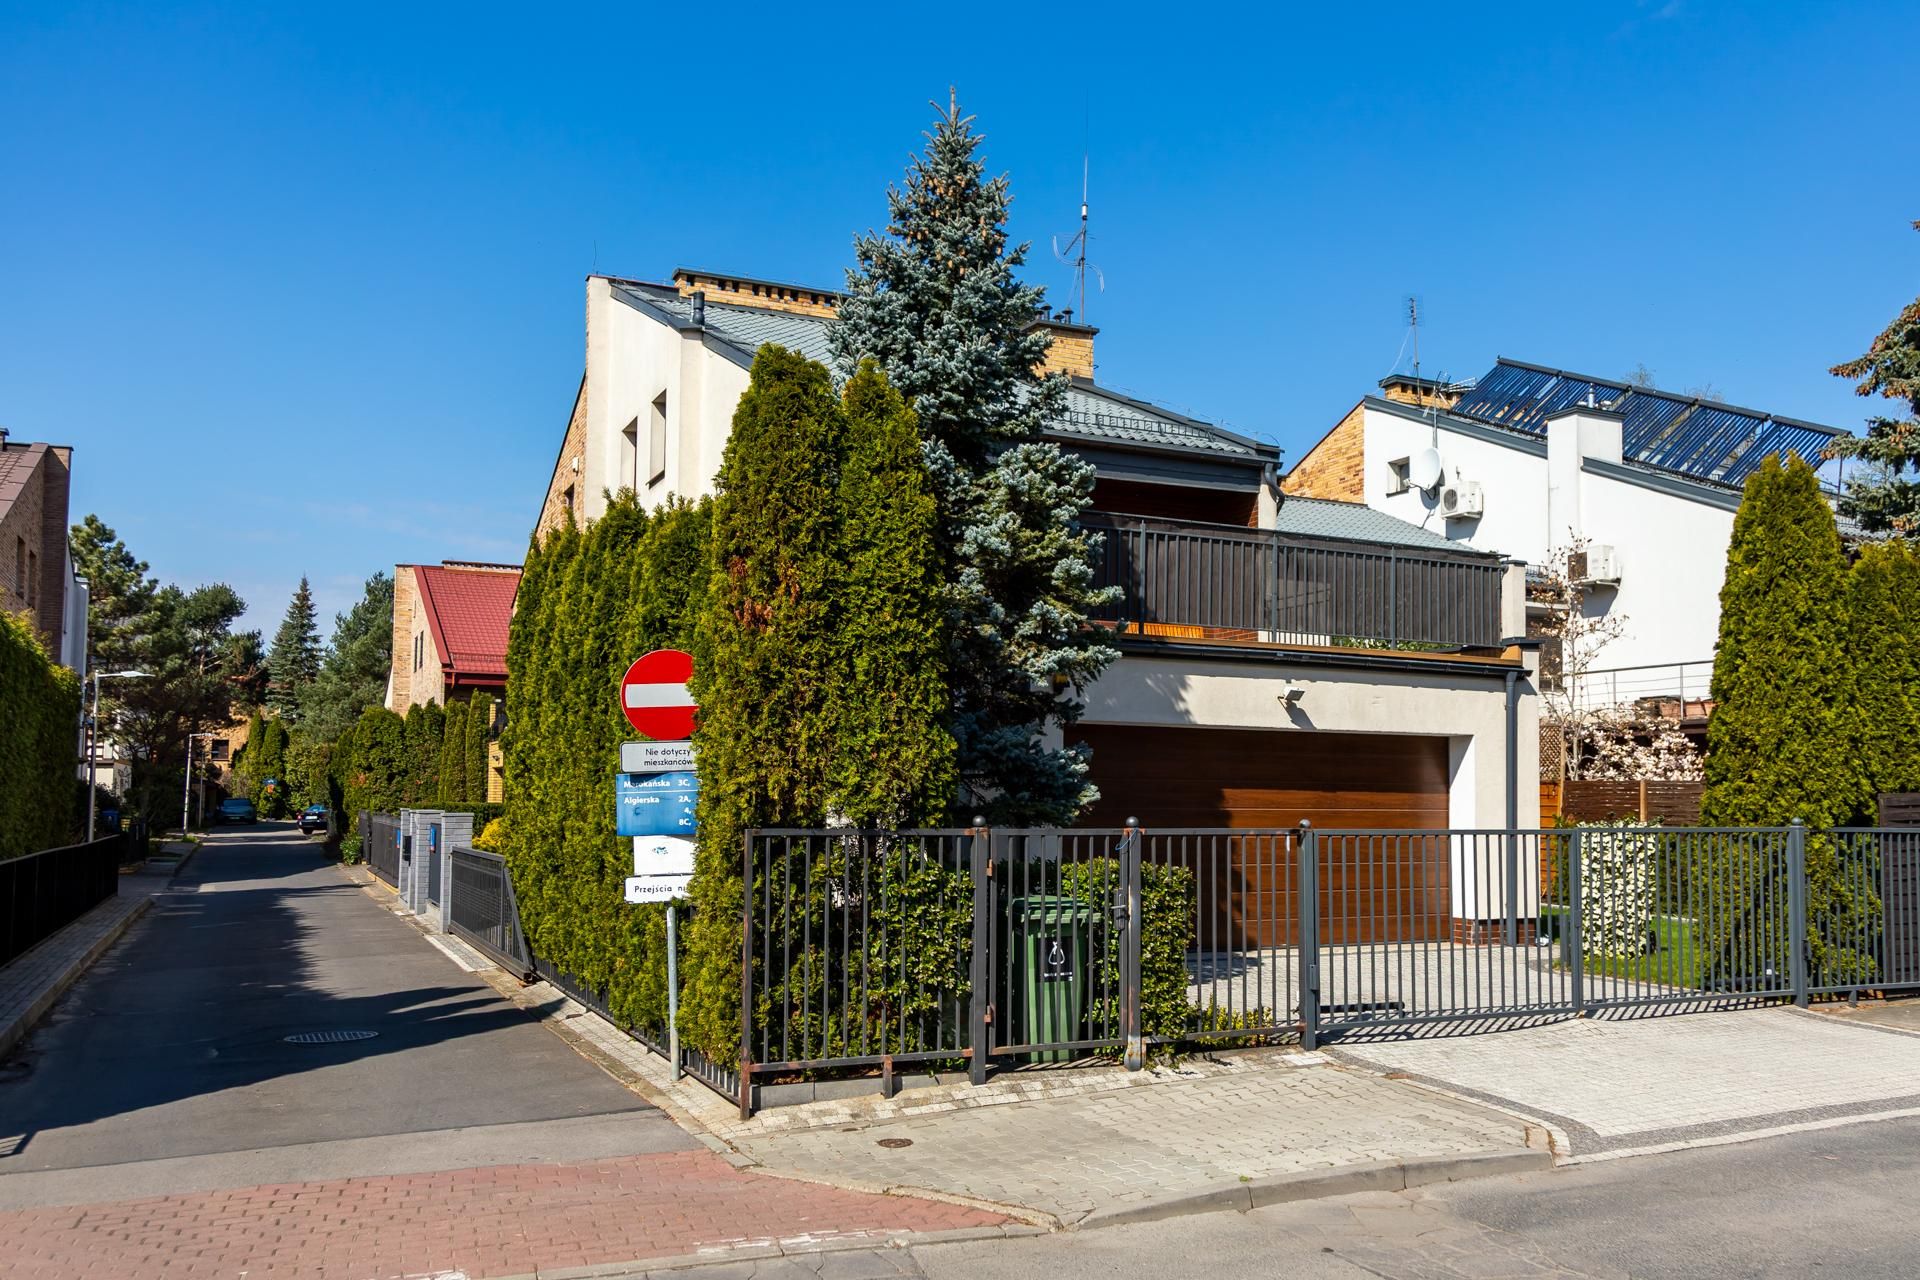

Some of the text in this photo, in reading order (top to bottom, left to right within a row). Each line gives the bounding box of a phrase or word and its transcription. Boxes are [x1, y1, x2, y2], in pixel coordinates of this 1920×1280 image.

[661, 748, 691, 757] dotyczy
[624, 795, 691, 805] Algierska 2A,
[634, 885, 672, 894] Przejścia
